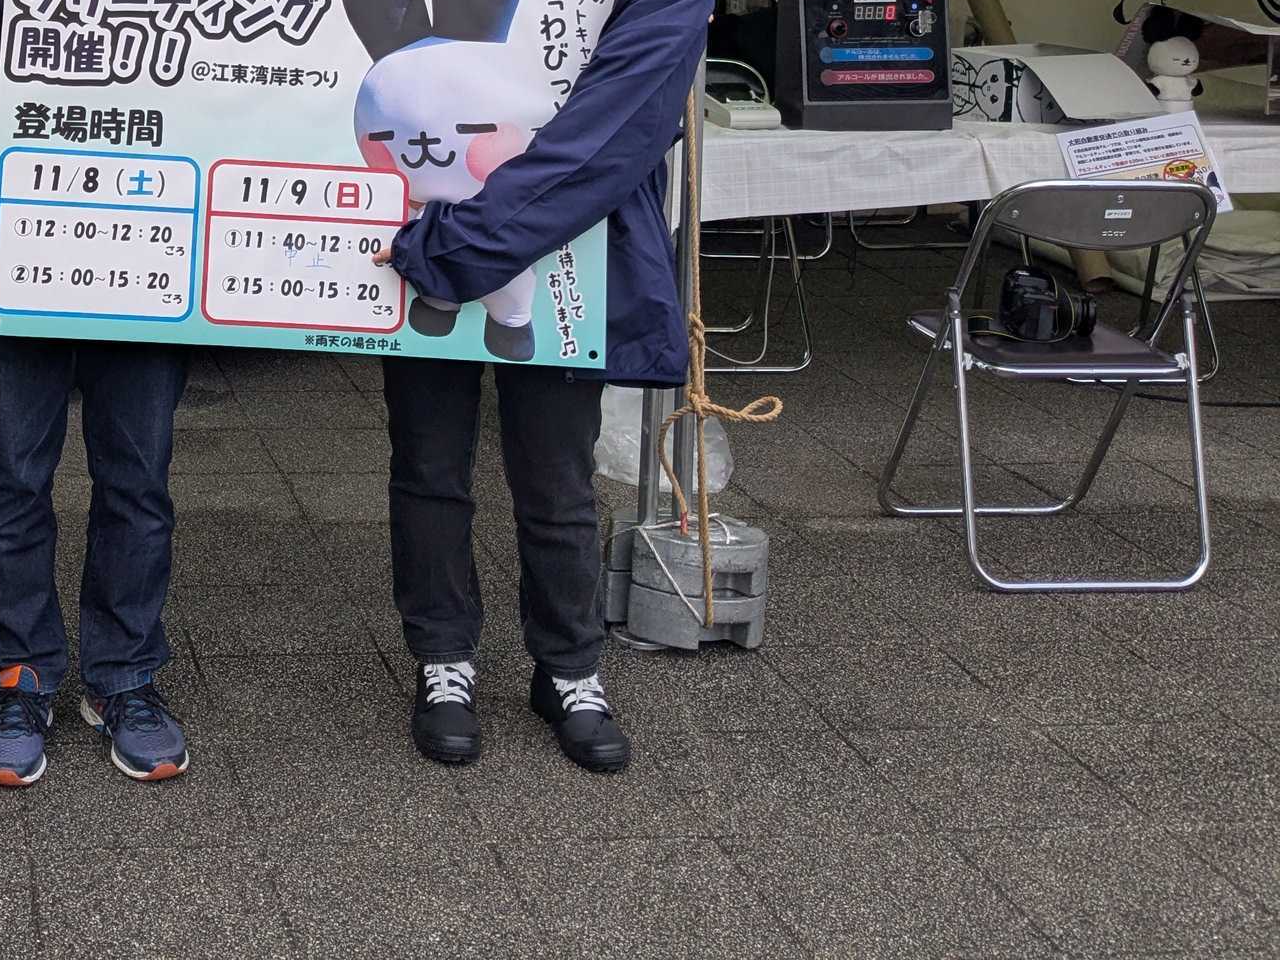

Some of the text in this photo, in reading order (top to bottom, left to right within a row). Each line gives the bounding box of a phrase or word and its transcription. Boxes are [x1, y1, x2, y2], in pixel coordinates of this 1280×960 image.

[191, 60, 339, 89] @江東湾岸まつり
[12, 101, 164, 147] 登場時間
[304, 334, 402, 352] ※雨天の場合中止
